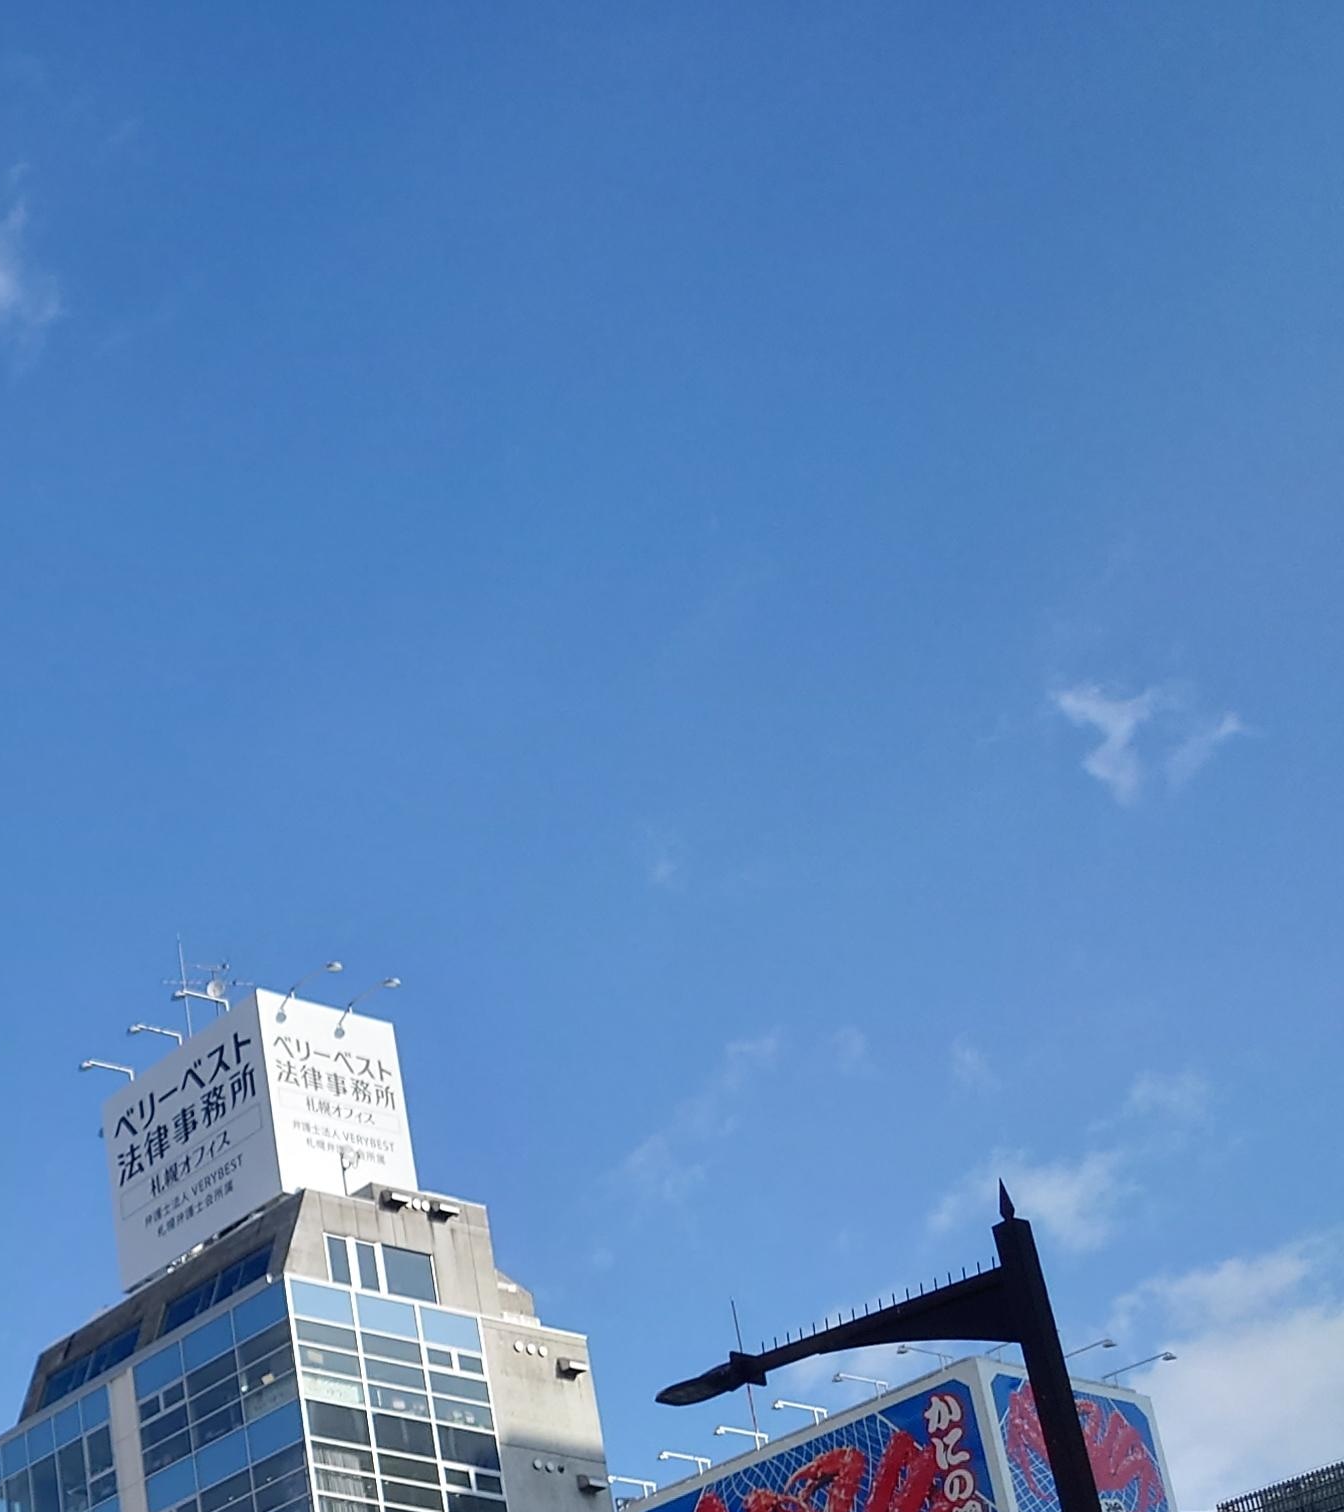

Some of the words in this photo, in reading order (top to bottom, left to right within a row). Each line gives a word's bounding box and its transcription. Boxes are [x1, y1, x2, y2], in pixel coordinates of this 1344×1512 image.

[273, 1036, 392, 1082] ベリーベスト
[114, 1032, 251, 1139] ベリーベスト
[275, 1059, 395, 1110] 法律事務所
[117, 1062, 256, 1187] 法律事務所
[306, 1096, 375, 1125] 札幌オフィス
[150, 1130, 230, 1197] 札幌オフィス
[342, 1130, 395, 1152] VERYBEST
[191, 1152, 244, 1197] VERYBEST
